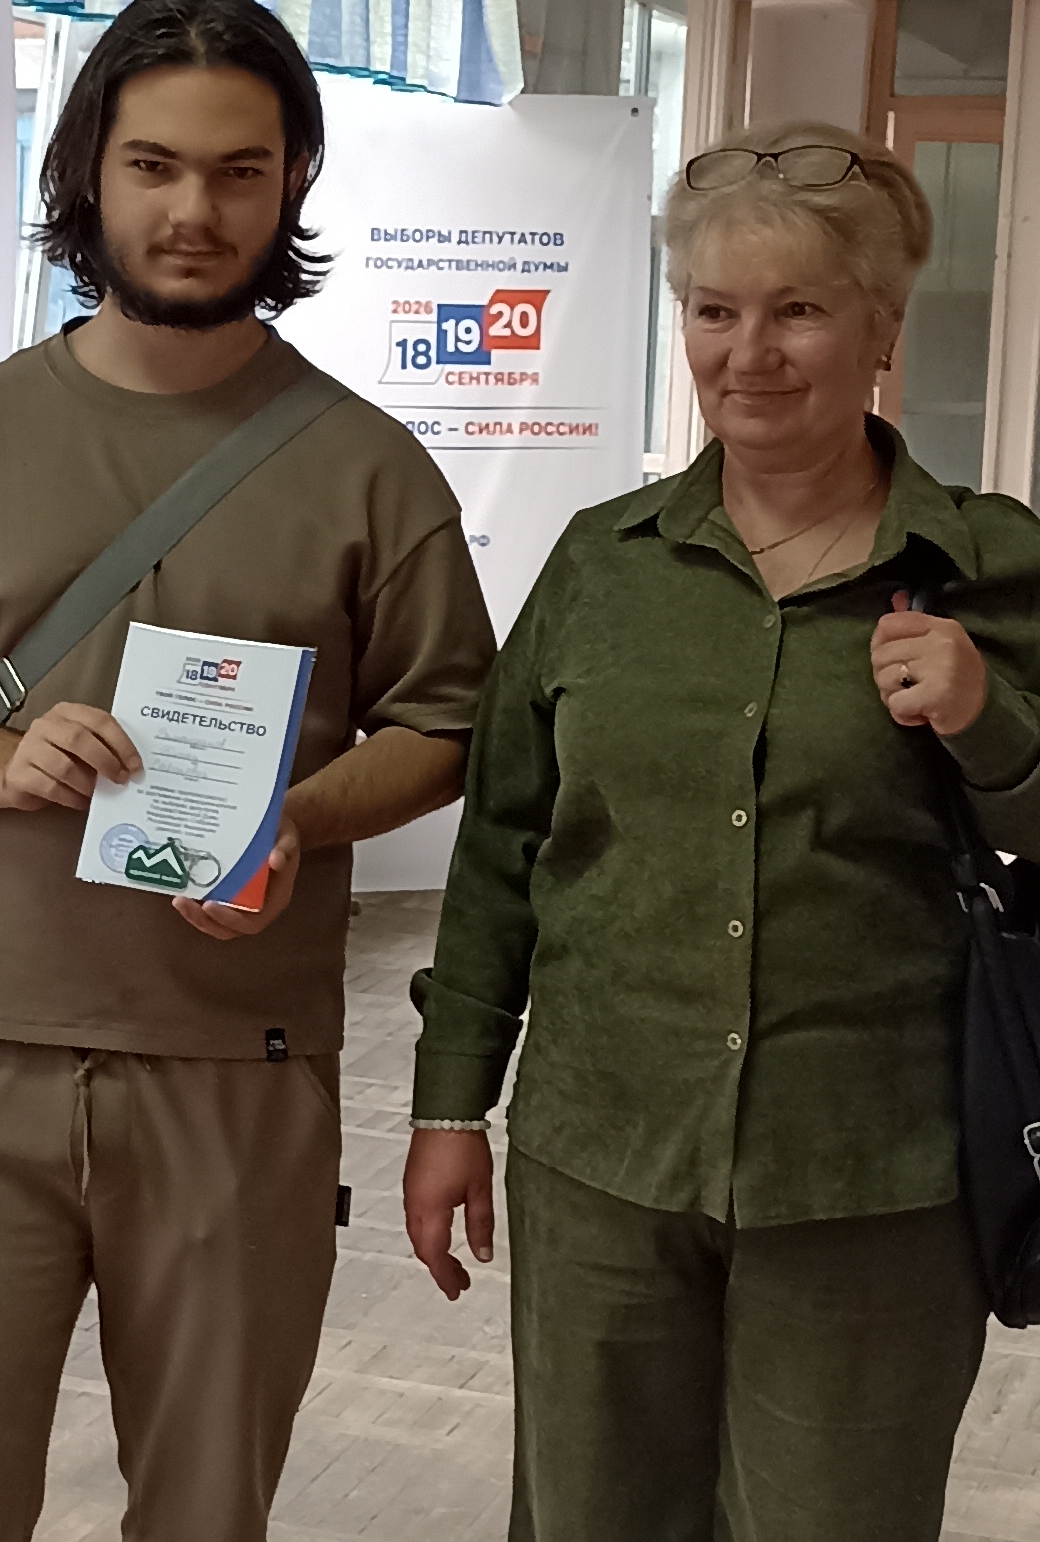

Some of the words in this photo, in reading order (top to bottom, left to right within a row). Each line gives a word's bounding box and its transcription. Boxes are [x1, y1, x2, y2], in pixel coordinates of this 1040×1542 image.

[370, 227, 452, 244] ВЫБОРЫ
[457, 229, 565, 247] ДЕПУТАТОВ
[365, 256, 517, 272] ГОСУДАРСТВЕННОЙ
[521, 260, 569, 274] ДУМЫ
[391, 300, 434, 315] 2026
[395, 338, 432, 370] 18
[441, 318, 481, 353] 19
[488, 302, 538, 337] 20
[444, 371, 540, 386] СЕНТЯБРЯ
[405, 420, 442, 436] ЛОС
[464, 421, 514, 436] СИЛА
[518, 422, 599, 437] РОССИИ!
[185, 668, 199, 681] 18
[220, 662, 238, 676] 20
[140, 705, 267, 737] СВИДЕТЕЛЬСТВО
